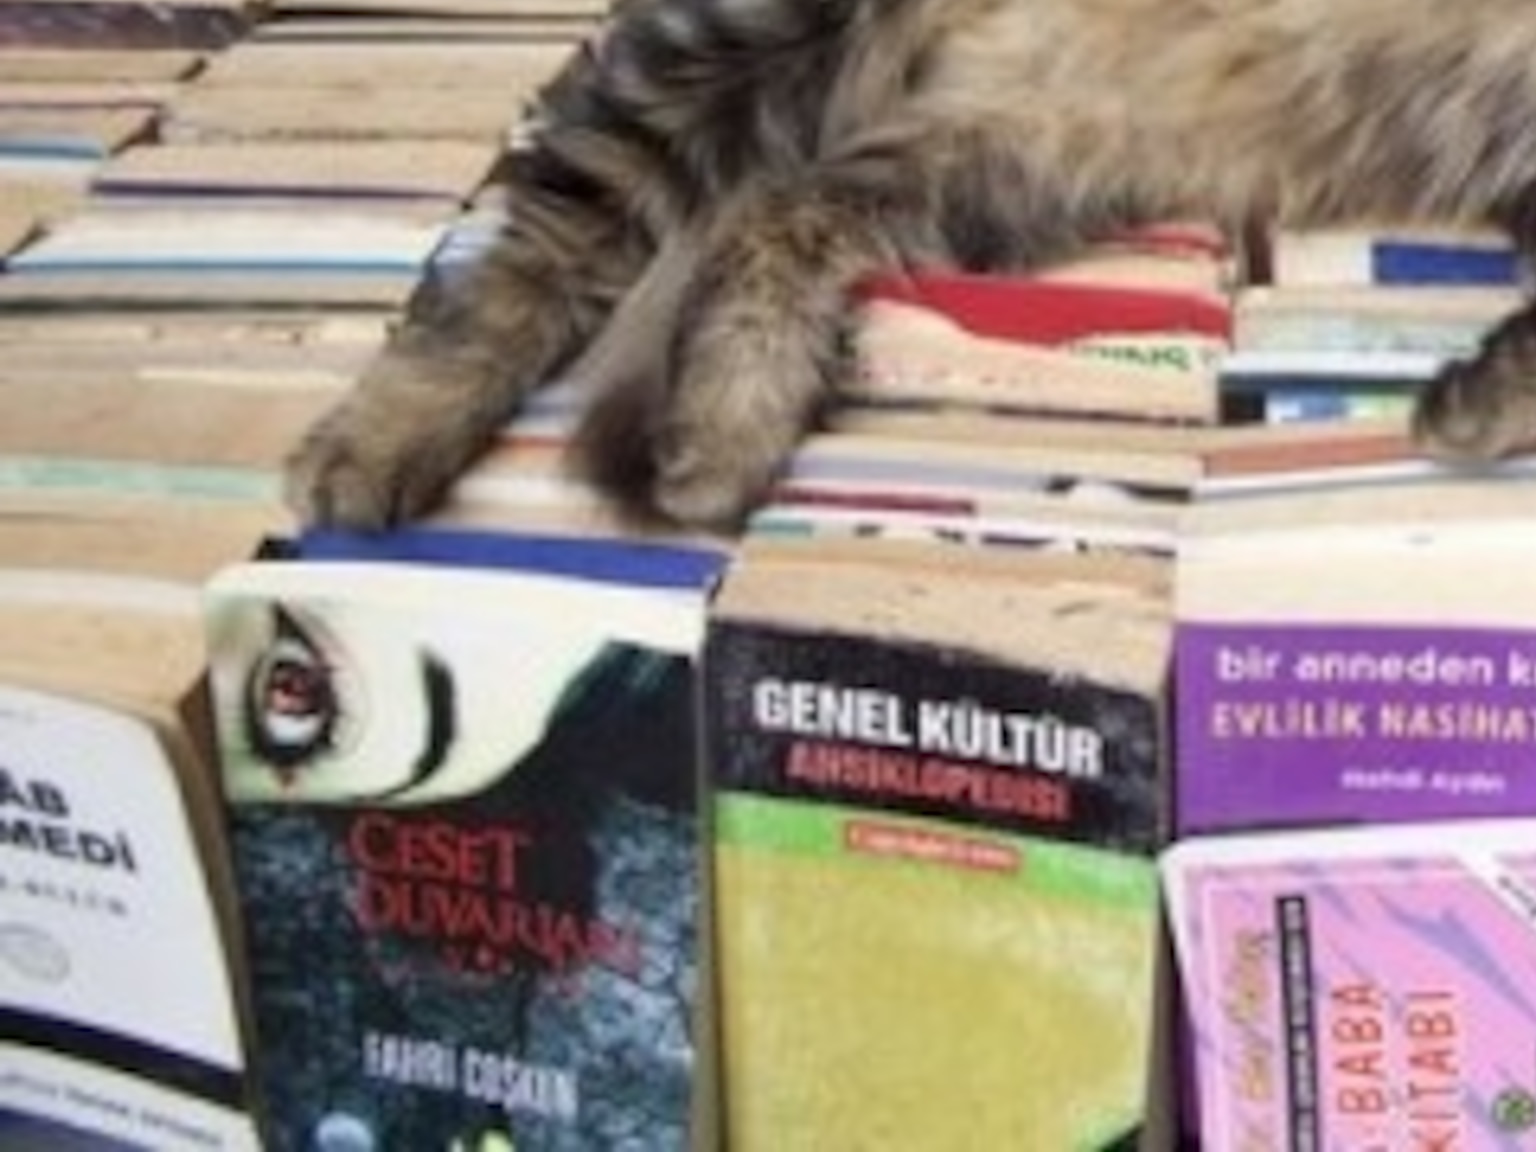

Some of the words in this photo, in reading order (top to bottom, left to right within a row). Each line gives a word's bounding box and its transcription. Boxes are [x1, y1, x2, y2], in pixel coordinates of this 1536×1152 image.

[1216, 647, 1278, 682] bir
[1293, 649, 1495, 686] anneden
[752, 679, 912, 745] GENEL
[918, 697, 1101, 778] KÜLTÜR
[1209, 699, 1366, 739] EVLİLİK
[348, 810, 531, 889] CESET
